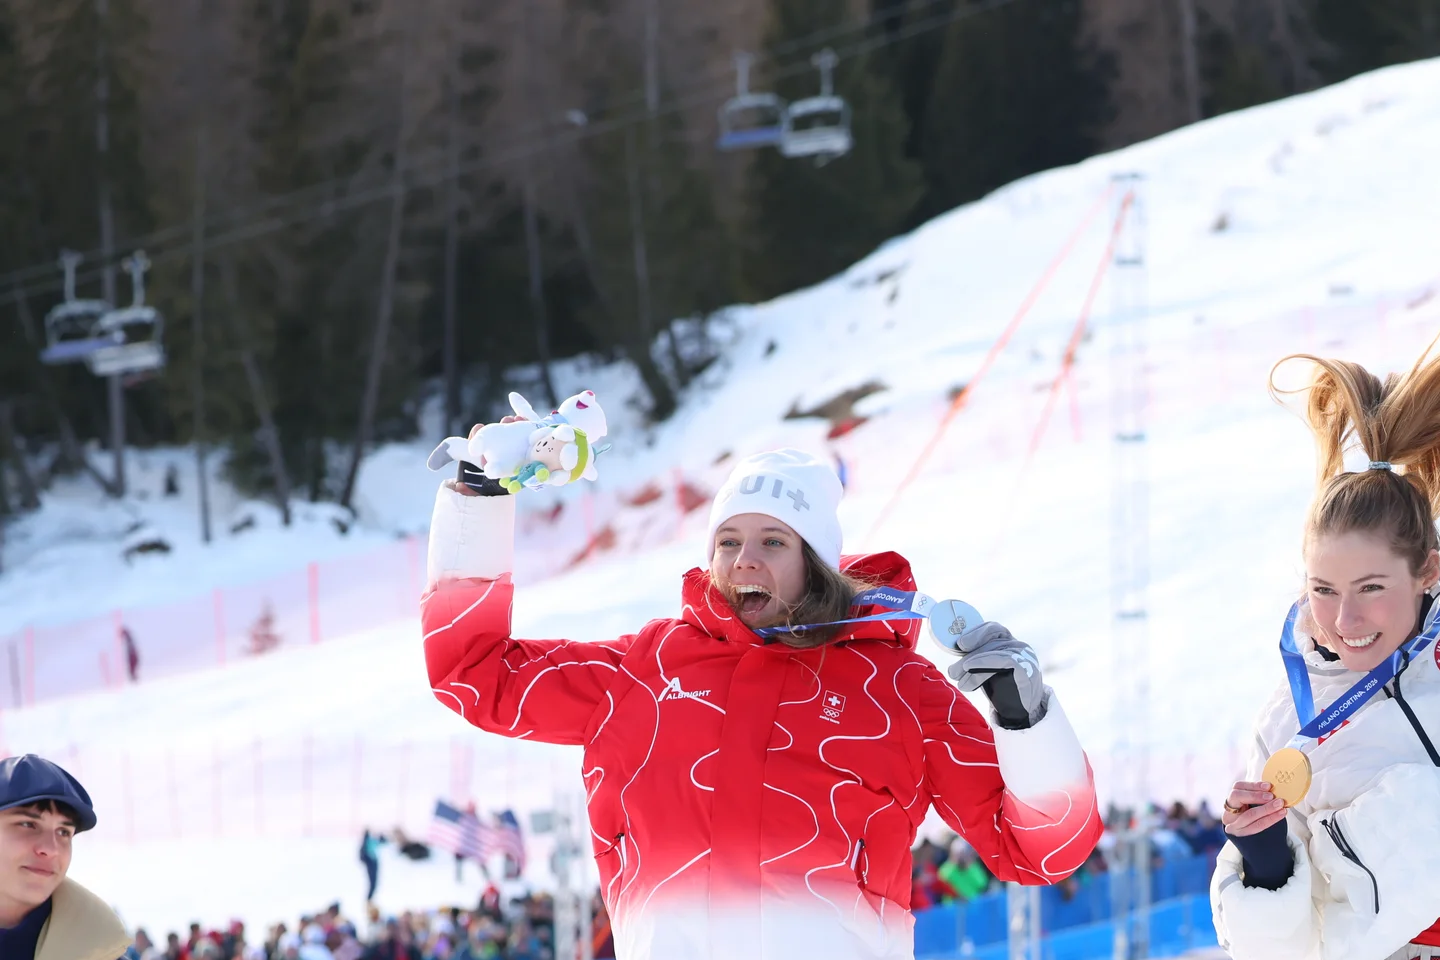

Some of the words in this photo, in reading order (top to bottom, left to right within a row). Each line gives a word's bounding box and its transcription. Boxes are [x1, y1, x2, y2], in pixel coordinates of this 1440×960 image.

[666, 690, 712, 700] ALBRIGHT
[1318, 709, 1340, 730] MILANO
[1338, 690, 1366, 712] CORTINA
[1364, 678, 1378, 691] 2026
